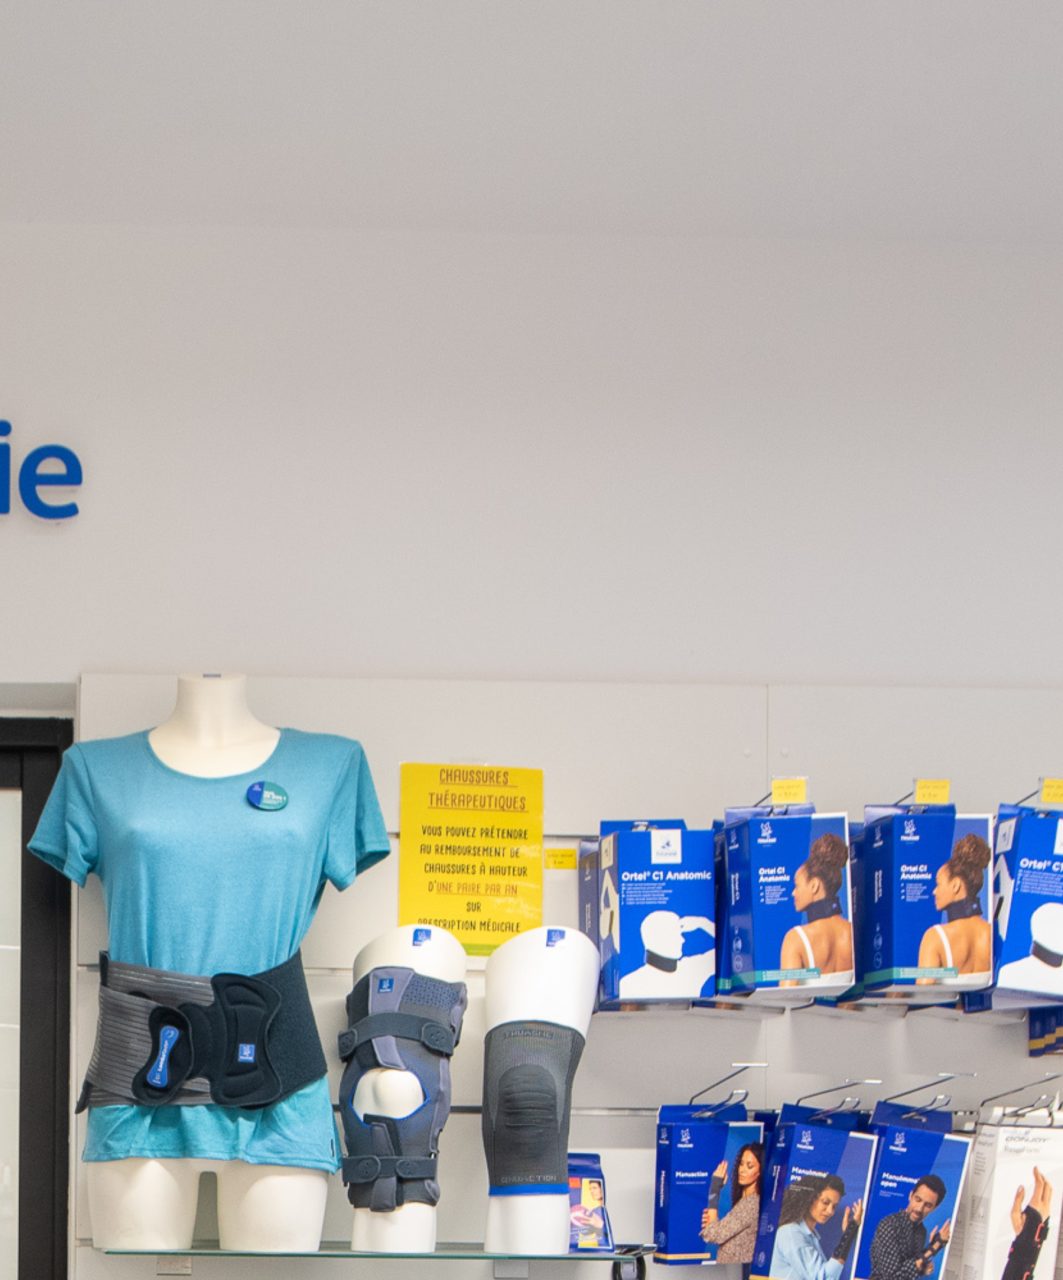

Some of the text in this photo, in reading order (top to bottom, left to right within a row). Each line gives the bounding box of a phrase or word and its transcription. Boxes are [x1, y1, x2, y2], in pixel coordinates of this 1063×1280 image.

[440, 769, 509, 785] CHAUSSURES
[429, 790, 526, 811] THÉRAPEUTIQUES
[422, 825, 528, 839] VOUS POUVEZ PRÉTENDRE
[420, 844, 520, 858] AU REMBOURSEMENT DE
[424, 862, 527, 877] CHAUSSURES À HAUTEUR
[652, 871, 663, 880] C1
[666, 870, 711, 881] Anatomic
[900, 872, 932, 880] Anatomic
[759, 874, 790, 882] Anatomic
[428, 880, 517, 895] D'UNE PAIRE PAR AN
[467, 902, 481, 912] SUR
[479, 918, 520, 932] MÉDICALE
